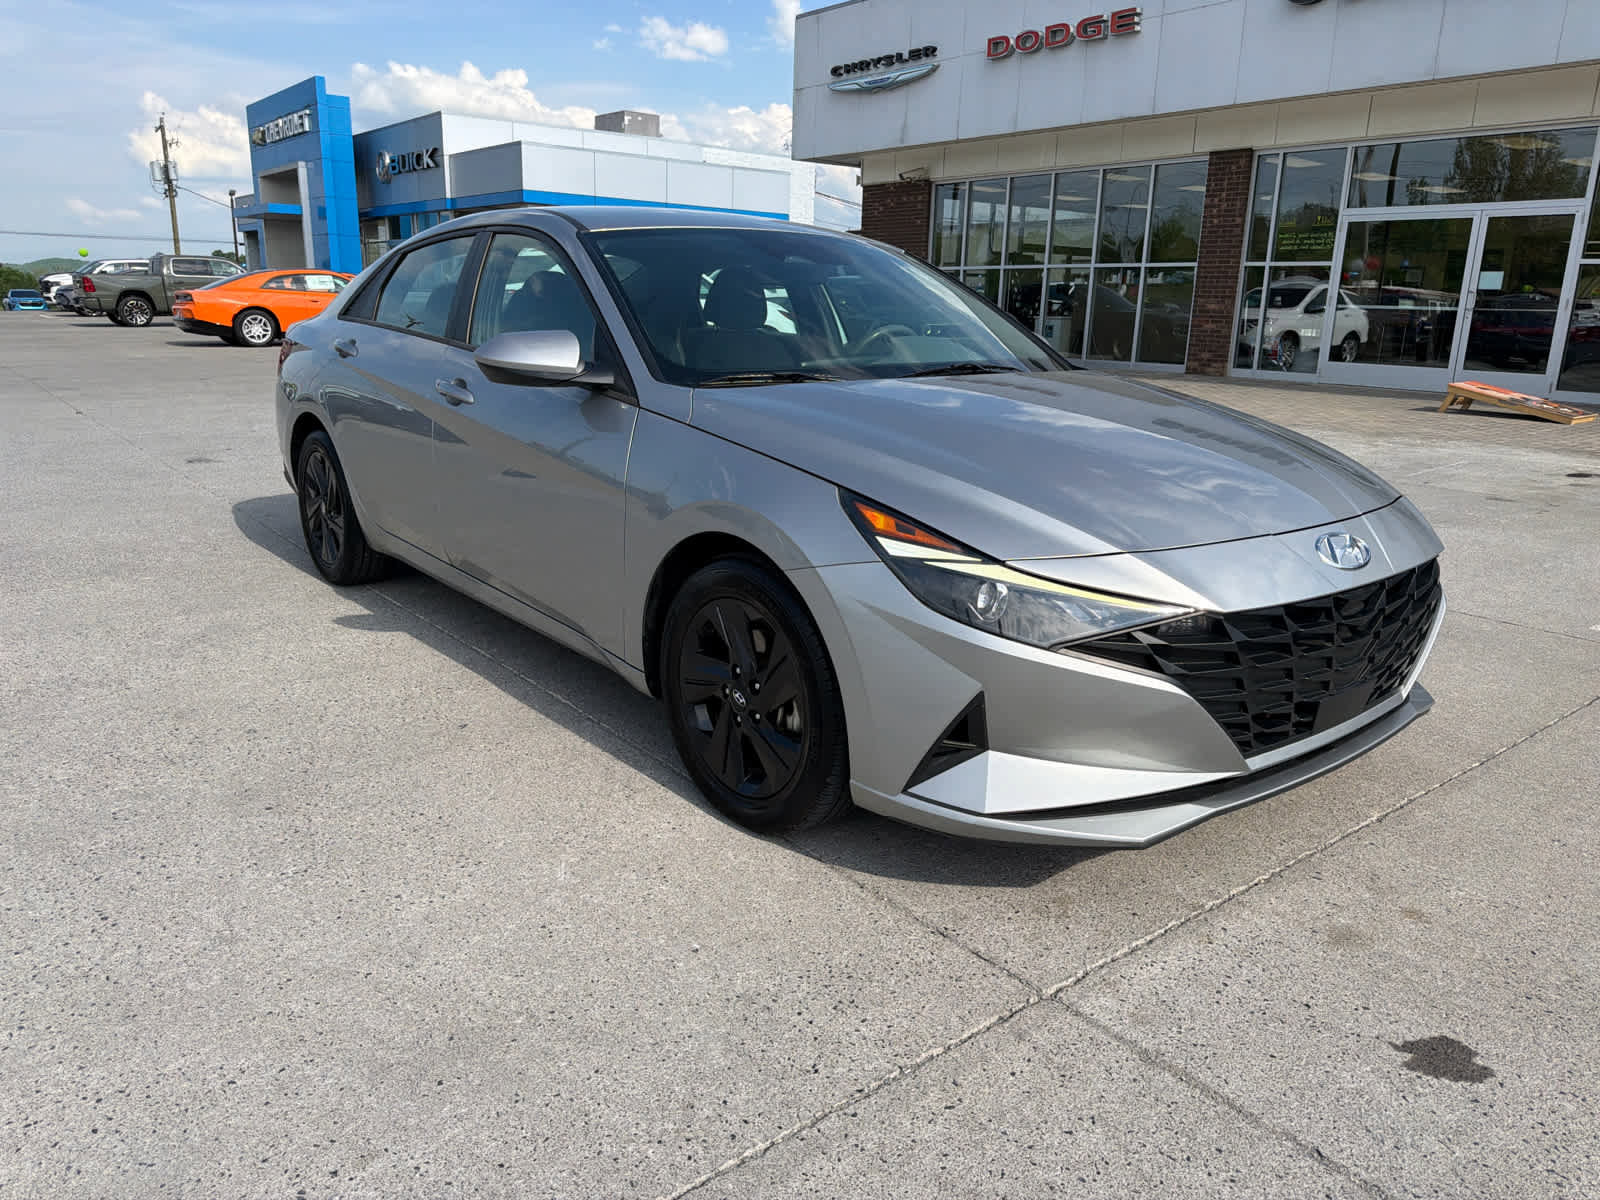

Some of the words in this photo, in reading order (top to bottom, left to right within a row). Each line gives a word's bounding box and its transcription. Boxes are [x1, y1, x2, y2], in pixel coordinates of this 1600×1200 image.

[986, 7, 1143, 60] DODGE
[830, 45, 938, 77] CHRYSLER
[265, 109, 311, 144] CHEVROLET
[388, 147, 438, 176] BUICK
